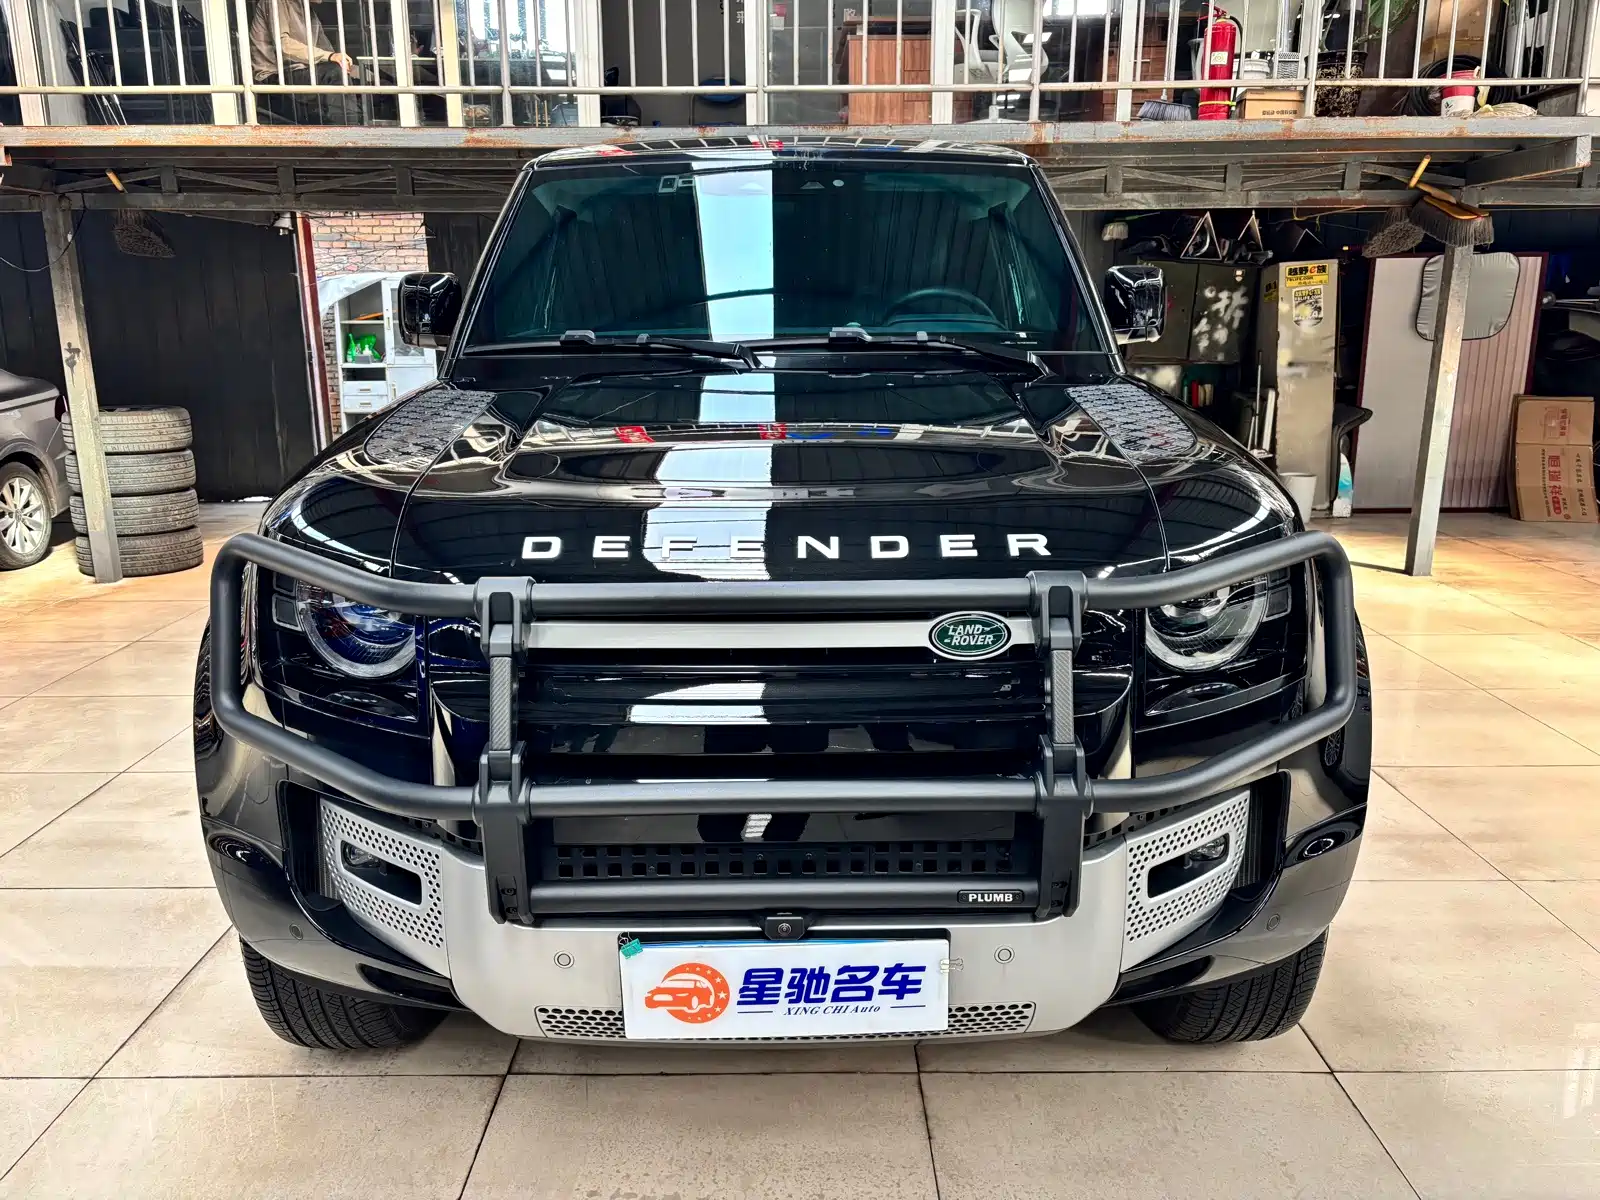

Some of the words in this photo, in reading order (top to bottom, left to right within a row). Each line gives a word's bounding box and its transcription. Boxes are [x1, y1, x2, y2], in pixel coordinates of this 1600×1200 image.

[521, 533, 1051, 560] DEFENDER
[948, 624, 983, 636] LAND
[951, 635, 994, 646] ROVER
[968, 893, 1013, 903] PLUMB
[736, 963, 927, 1006] 星驰名车
[783, 1005, 821, 1016] XING
[823, 1005, 848, 1015] CHI
[851, 1004, 881, 1015] Auto
